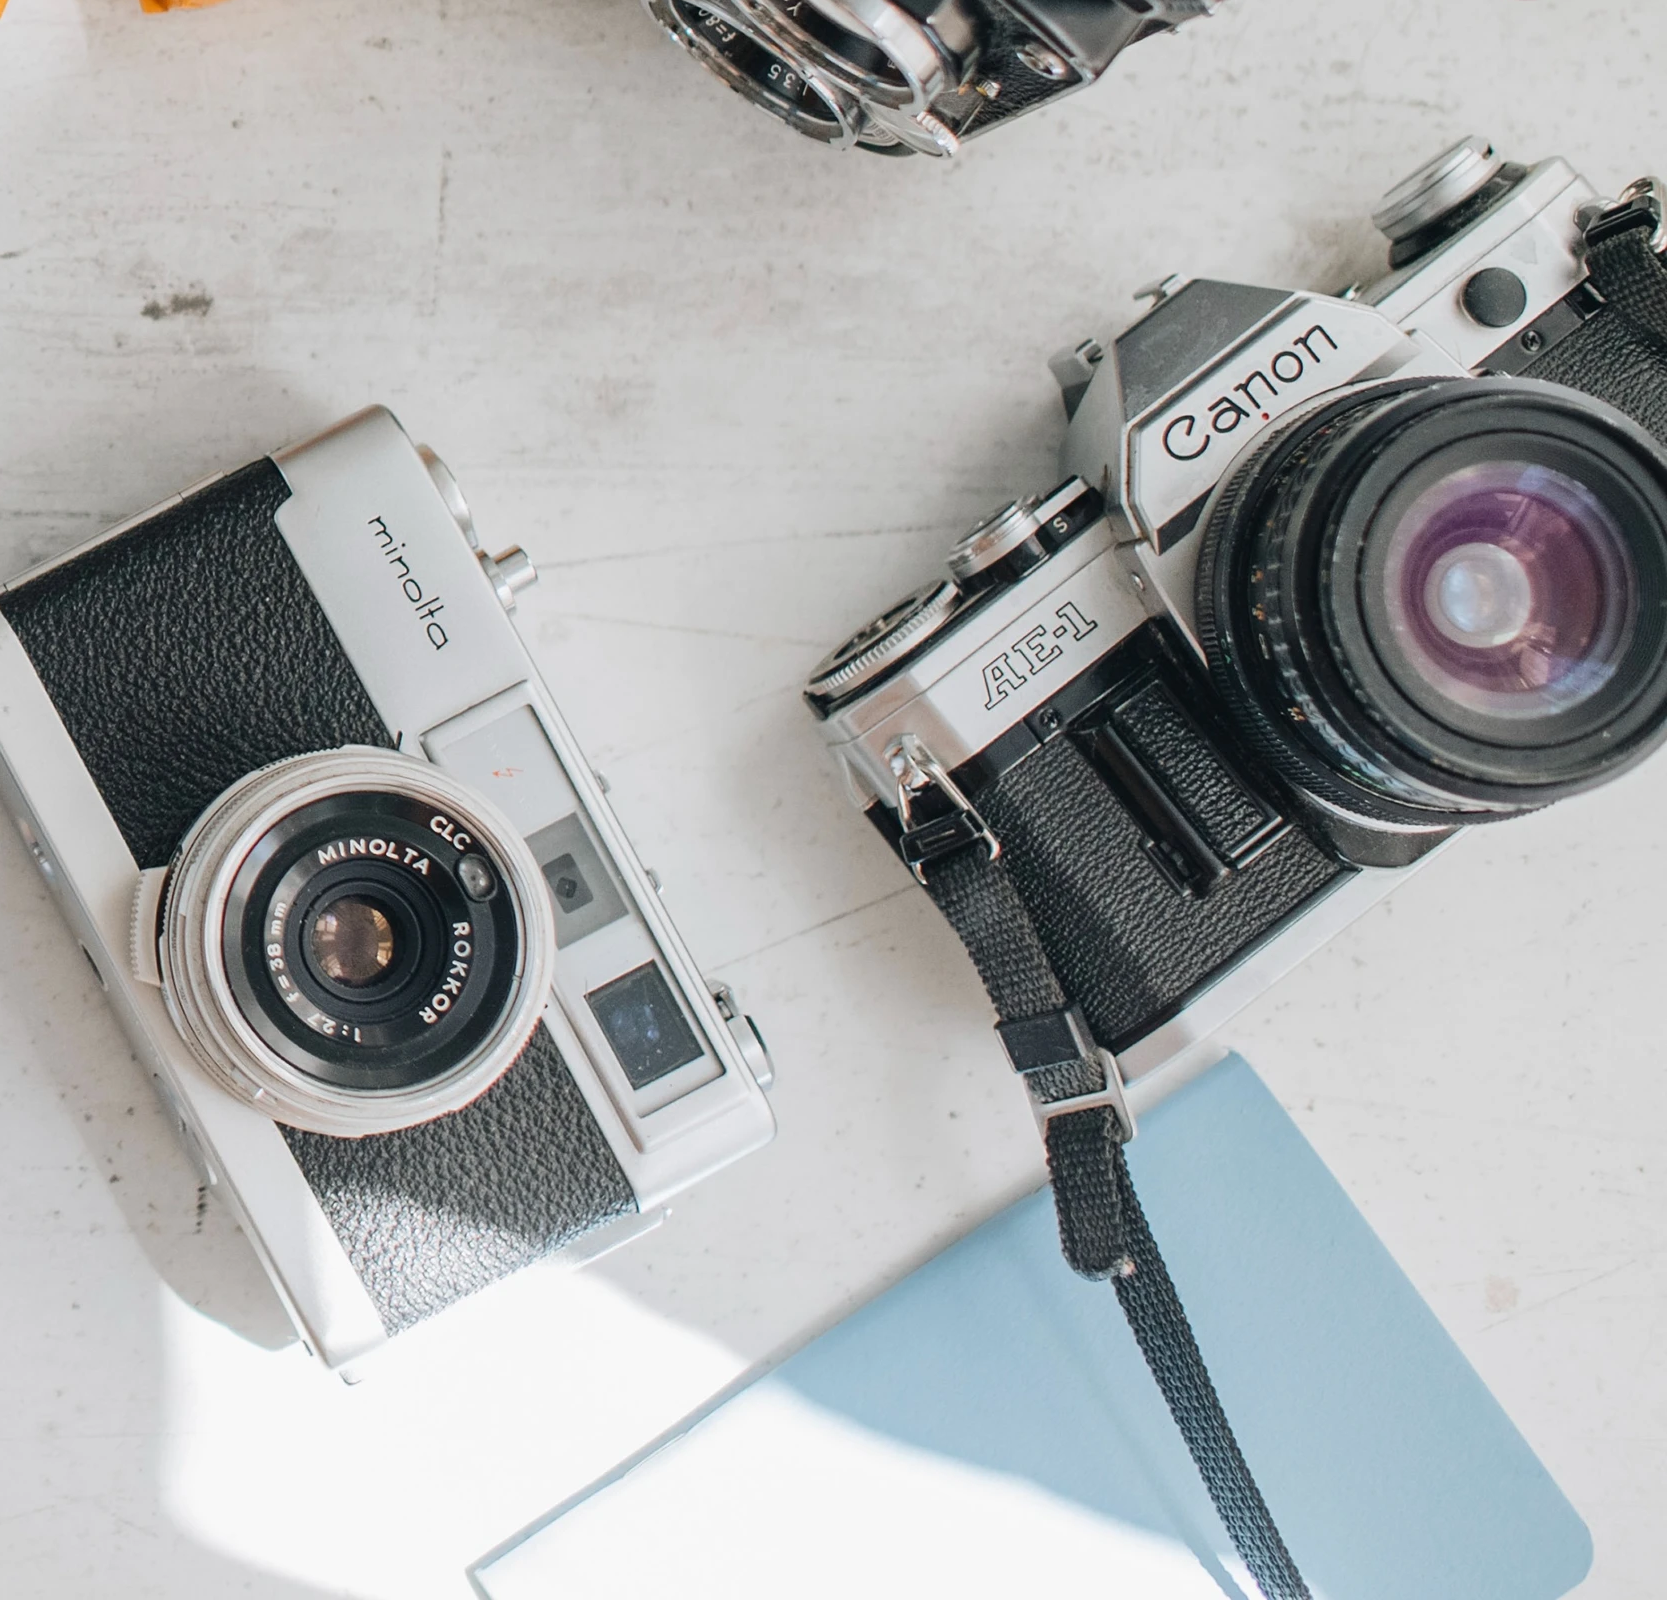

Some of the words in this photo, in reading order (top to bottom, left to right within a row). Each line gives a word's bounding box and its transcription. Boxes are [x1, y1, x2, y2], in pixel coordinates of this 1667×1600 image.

[1162, 324, 1338, 461] Canon
[368, 516, 448, 650] minolta
[981, 601, 1098, 711] AE-1
[430, 816, 472, 850] CLC
[317, 838, 430, 876] MINOLTA
[419, 921, 471, 1024] ROKKOR
